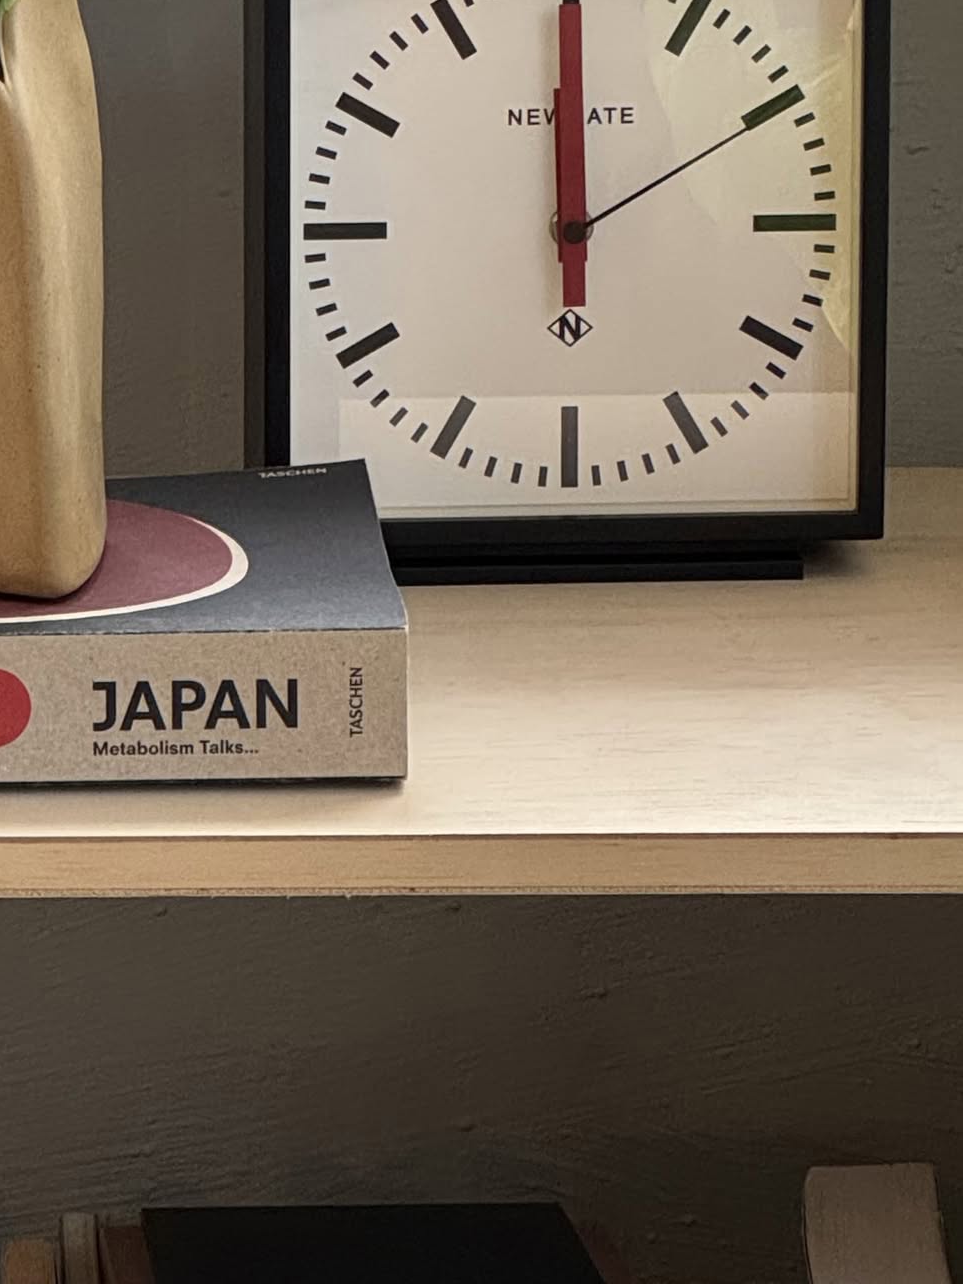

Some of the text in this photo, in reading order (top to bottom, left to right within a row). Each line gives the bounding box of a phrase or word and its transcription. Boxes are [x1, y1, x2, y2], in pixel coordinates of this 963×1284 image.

[257, 468, 327, 479] TASCHEN
[92, 678, 298, 732] JAPAN
[348, 667, 363, 738] TASCHEN
[93, 739, 259, 756] Metabolism Talks...
